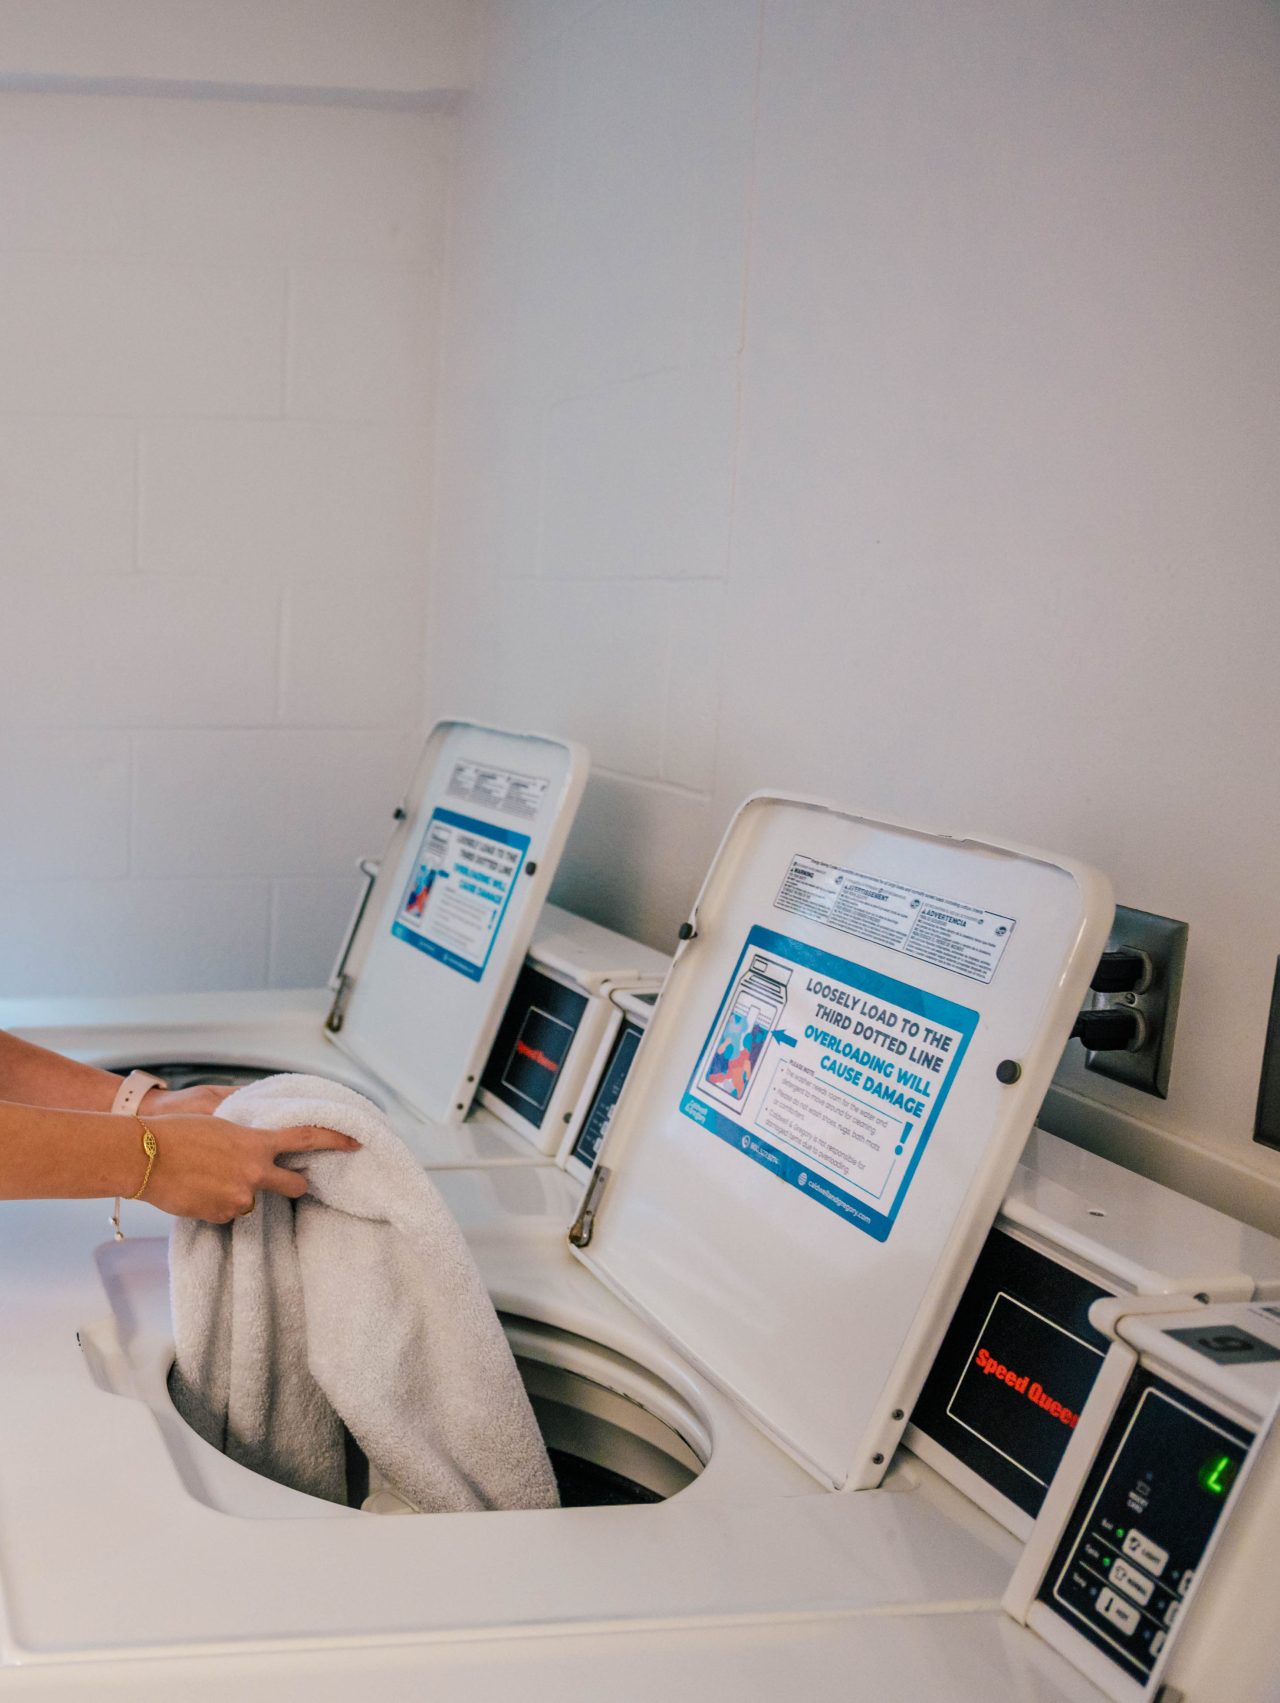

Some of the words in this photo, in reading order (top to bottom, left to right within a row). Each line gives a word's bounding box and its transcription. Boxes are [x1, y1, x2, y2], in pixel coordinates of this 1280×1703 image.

[794, 867, 814, 878] WARNING
[926, 909, 967, 927] ADVERTENCIA
[805, 978, 860, 1011] LOOSELY
[859, 1001, 899, 1028] LOAD
[898, 1017, 921, 1038] TO
[920, 1027, 953, 1052] THE
[813, 1003, 853, 1031] THIRD
[852, 1020, 909, 1057] DOTTED
[908, 1046, 944, 1073] LINE
[802, 1023, 895, 1078] OVERLOADING
[894, 1067, 934, 1097] WILL
[818, 1053, 863, 1086] CAUSE
[861, 1075, 925, 1118] DAMAGE
[807, 1178, 872, 1225] caldwellandgregory.com
[976, 1348, 1030, 1394] Speed
